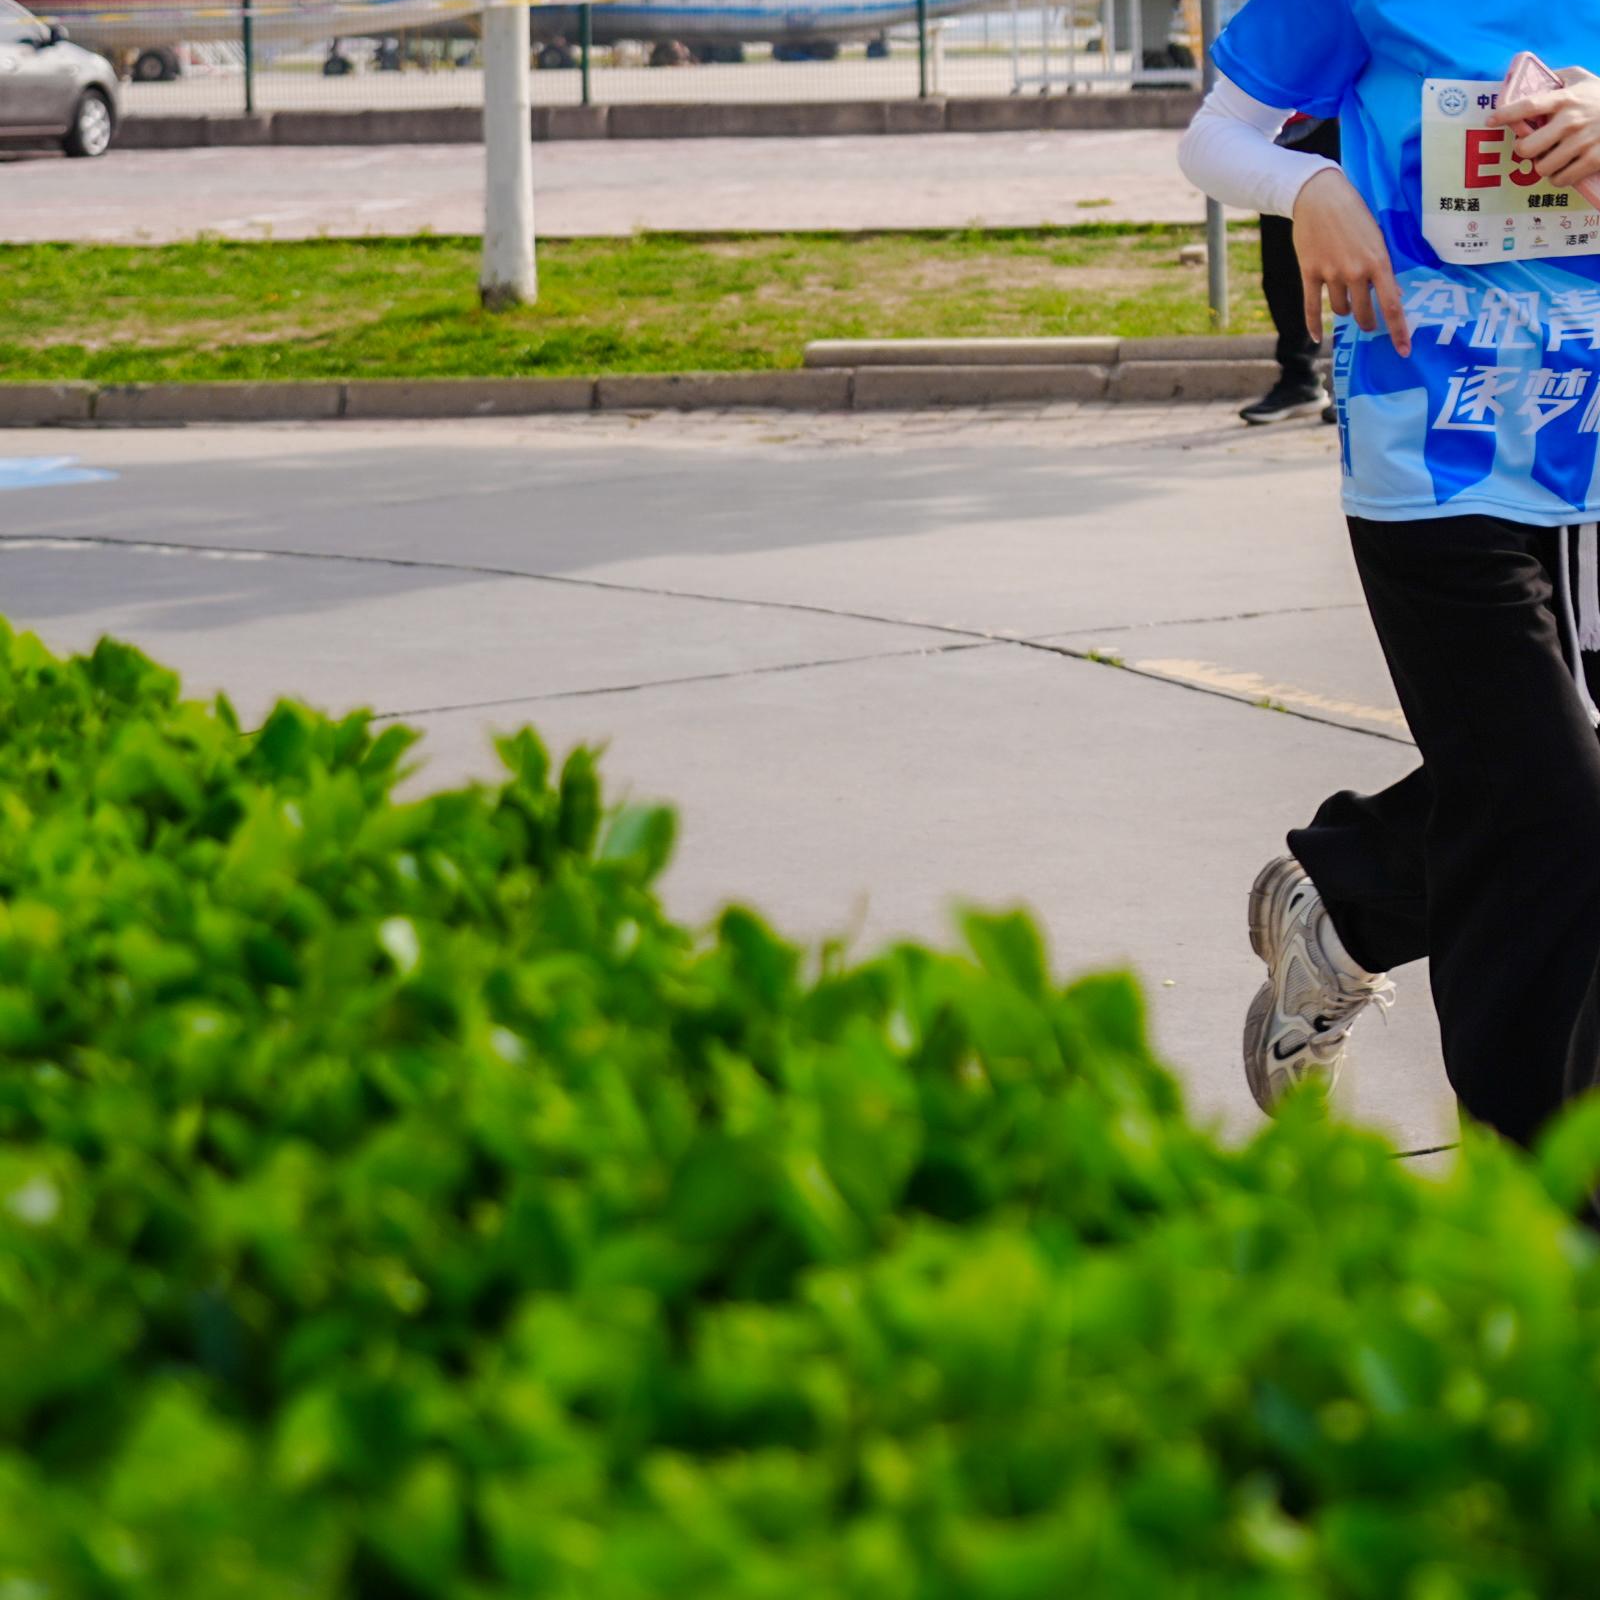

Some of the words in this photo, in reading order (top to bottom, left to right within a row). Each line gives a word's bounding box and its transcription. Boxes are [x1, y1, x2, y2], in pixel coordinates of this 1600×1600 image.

[1439, 196, 1481, 212] 郑紫涵
[1527, 193, 1569, 209] 健康组
